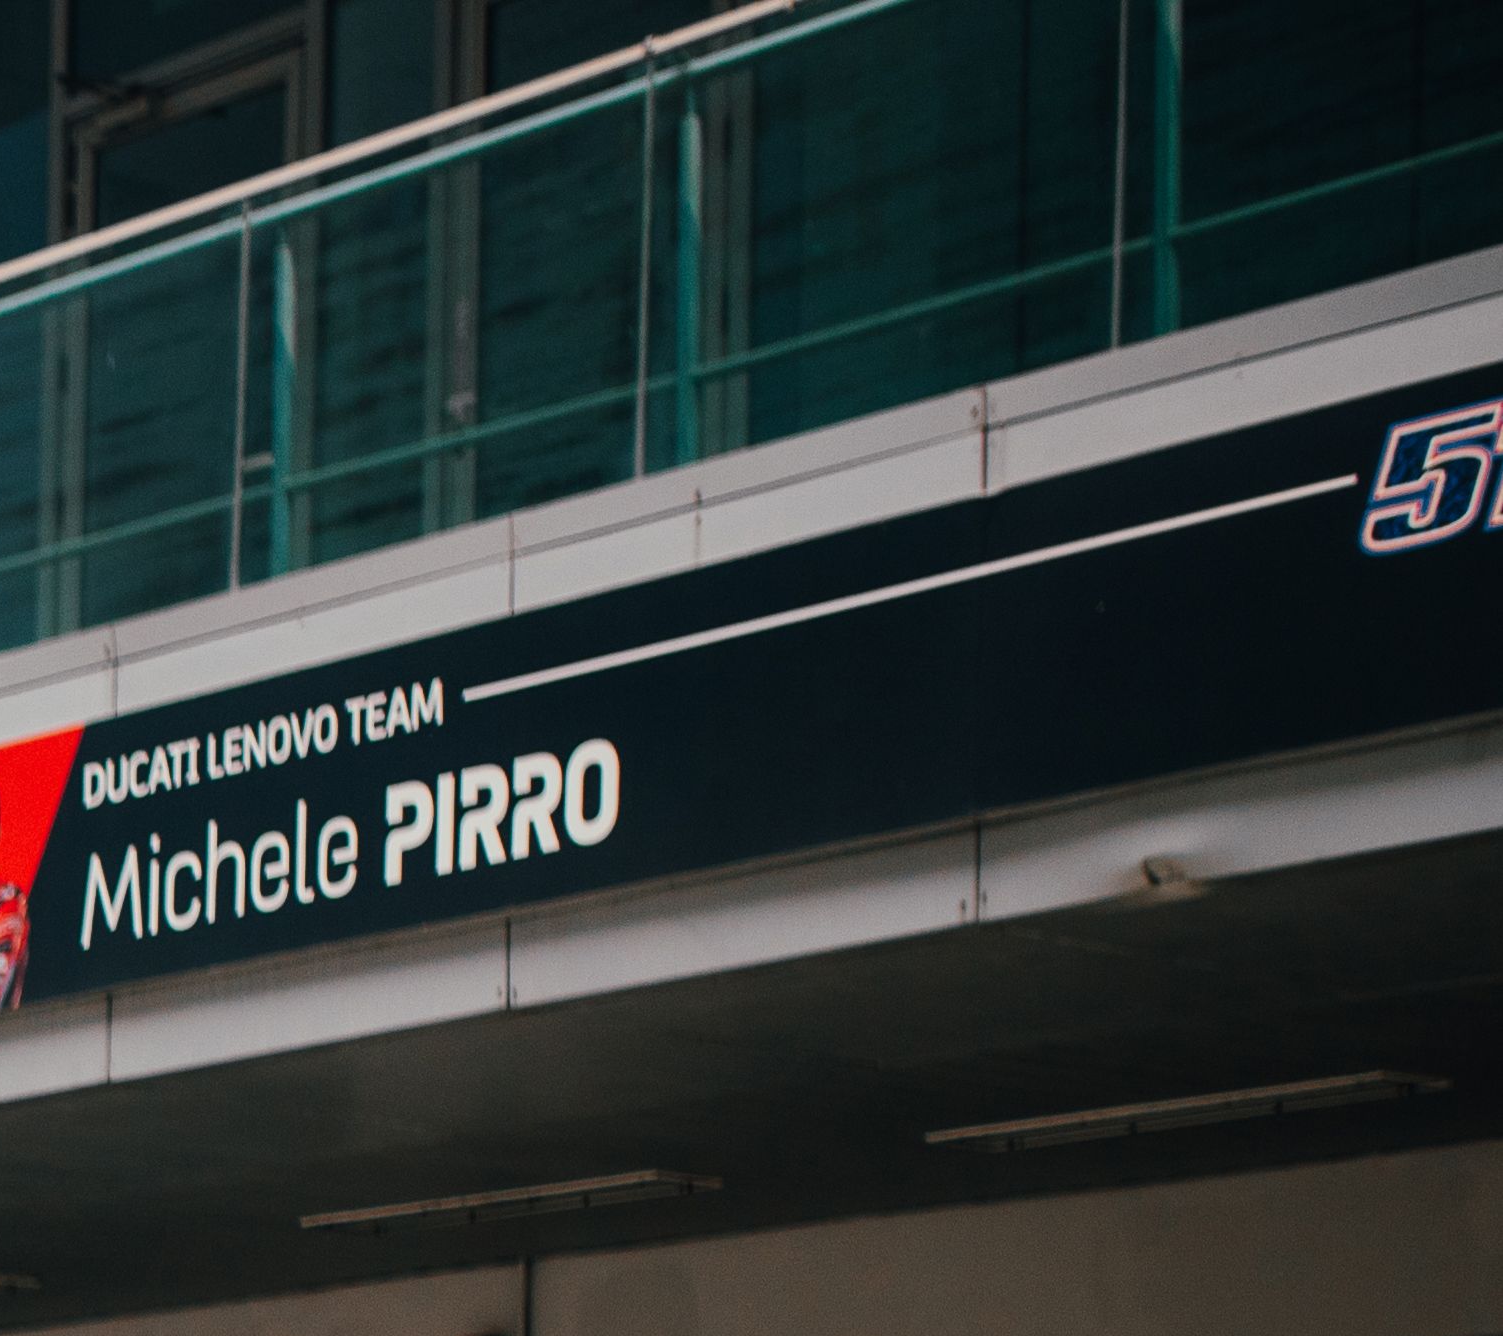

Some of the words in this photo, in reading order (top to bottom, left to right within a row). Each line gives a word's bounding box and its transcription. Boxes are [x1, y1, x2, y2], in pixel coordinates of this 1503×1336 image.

[1361, 398, 1503, 555] 5
[82, 736, 201, 811] DUCATI
[207, 703, 339, 780] LENOVO
[344, 677, 444, 747] TEAM
[80, 798, 359, 951] Michele
[384, 737, 621, 887] PIRRO
